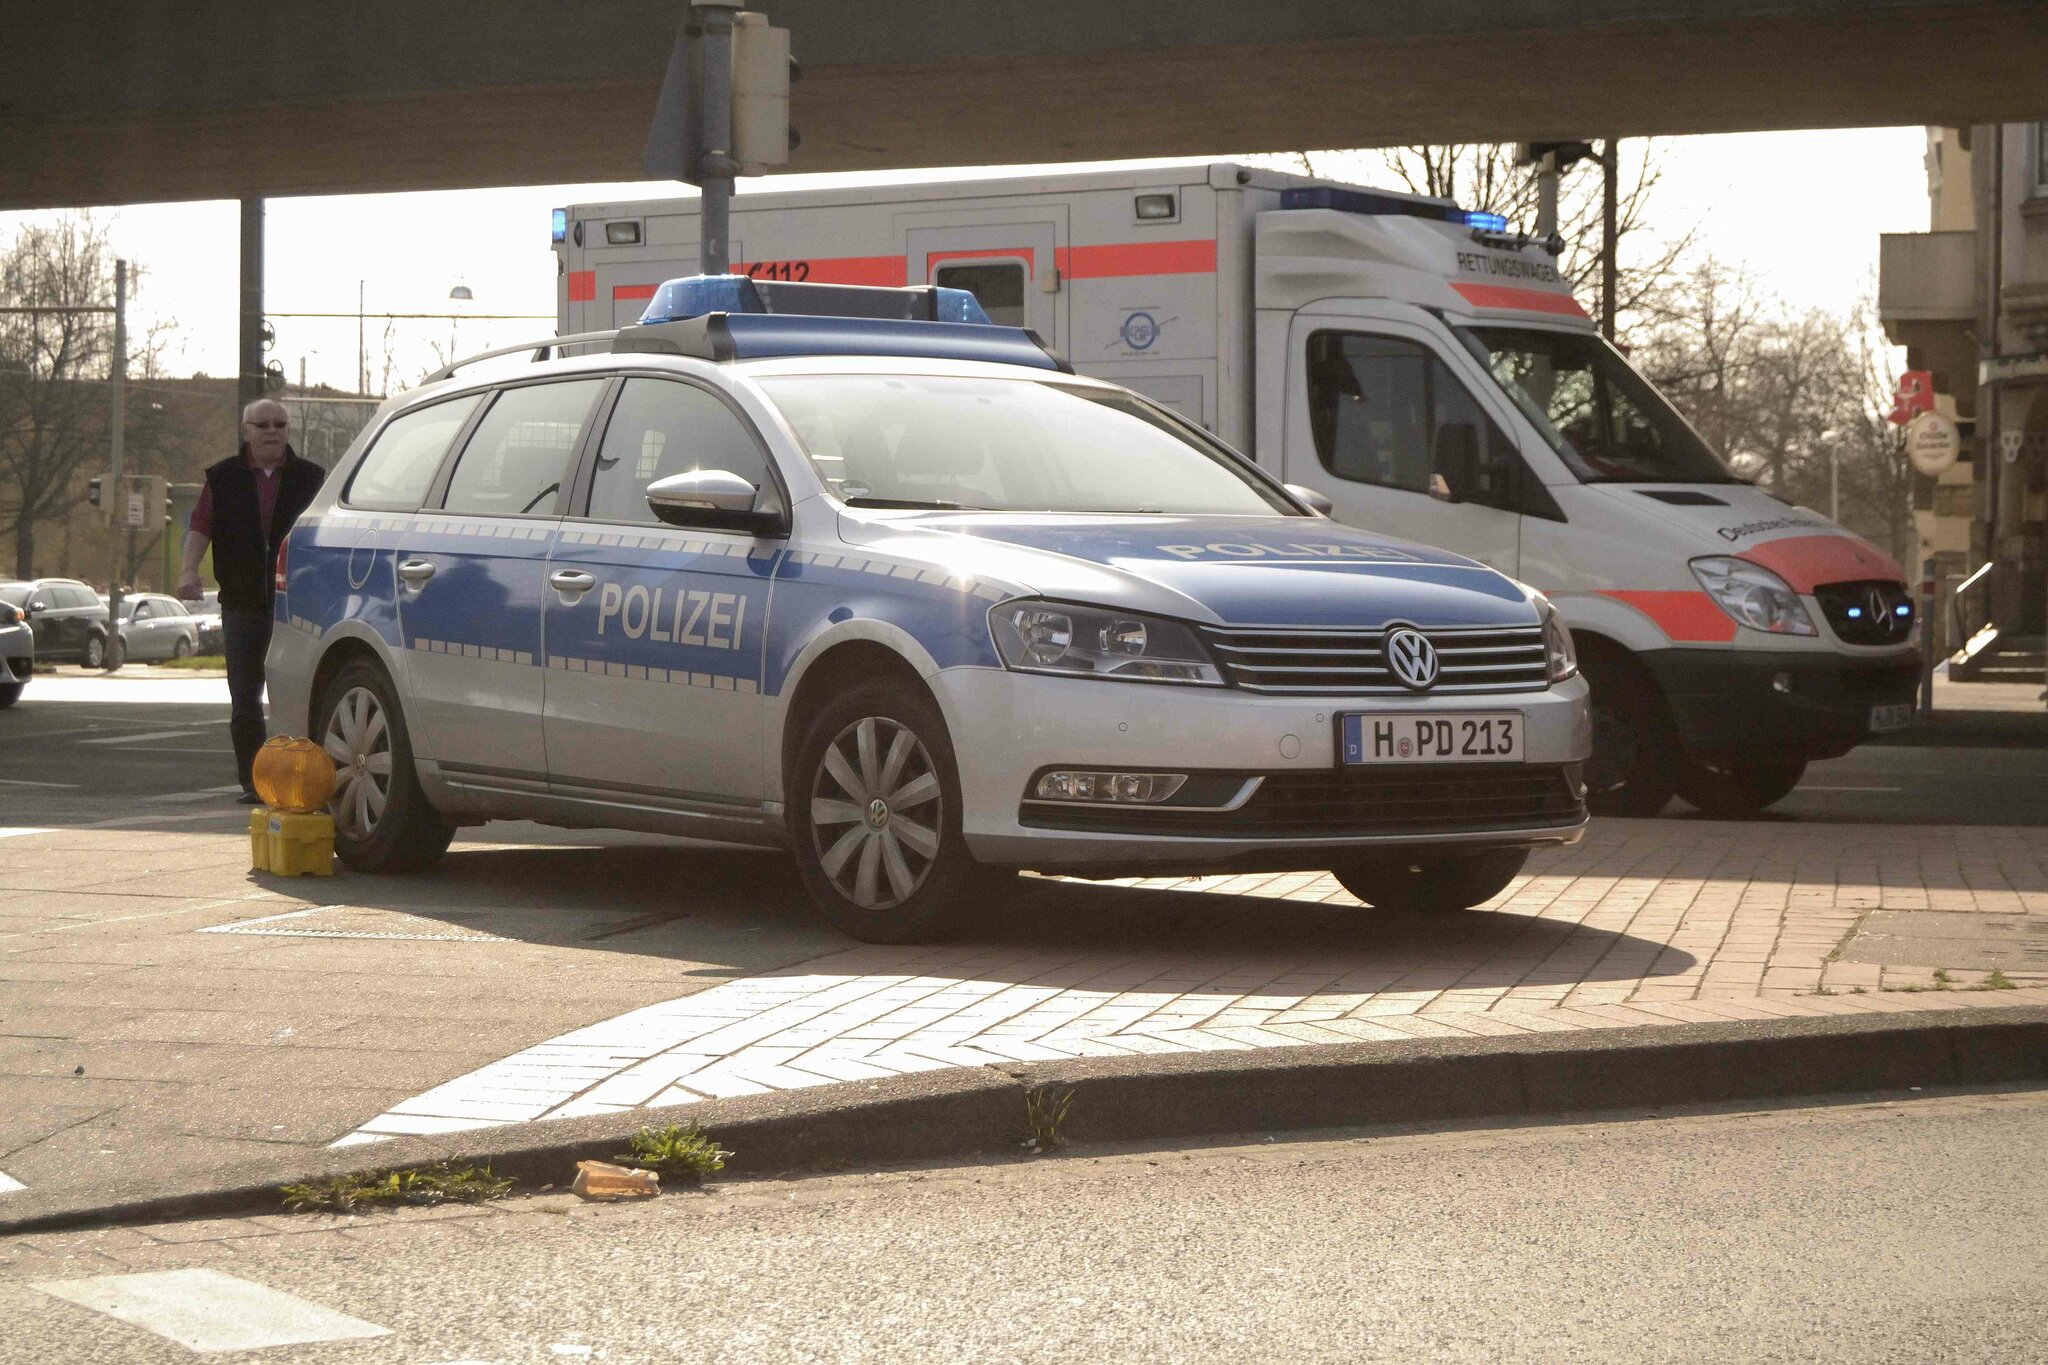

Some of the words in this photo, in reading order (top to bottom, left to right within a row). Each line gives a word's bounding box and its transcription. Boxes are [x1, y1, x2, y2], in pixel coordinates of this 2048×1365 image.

[765, 261, 810, 283] 112
[1457, 252, 1560, 283] RETTUNGSWAGEN
[1154, 543, 1425, 561] POLIZEI
[597, 582, 748, 651] POLIZEI
[1350, 744, 1358, 755] D
[1374, 721, 1394, 757] H
[1415, 720, 1454, 756] PD
[1461, 719, 1513, 756] 213
